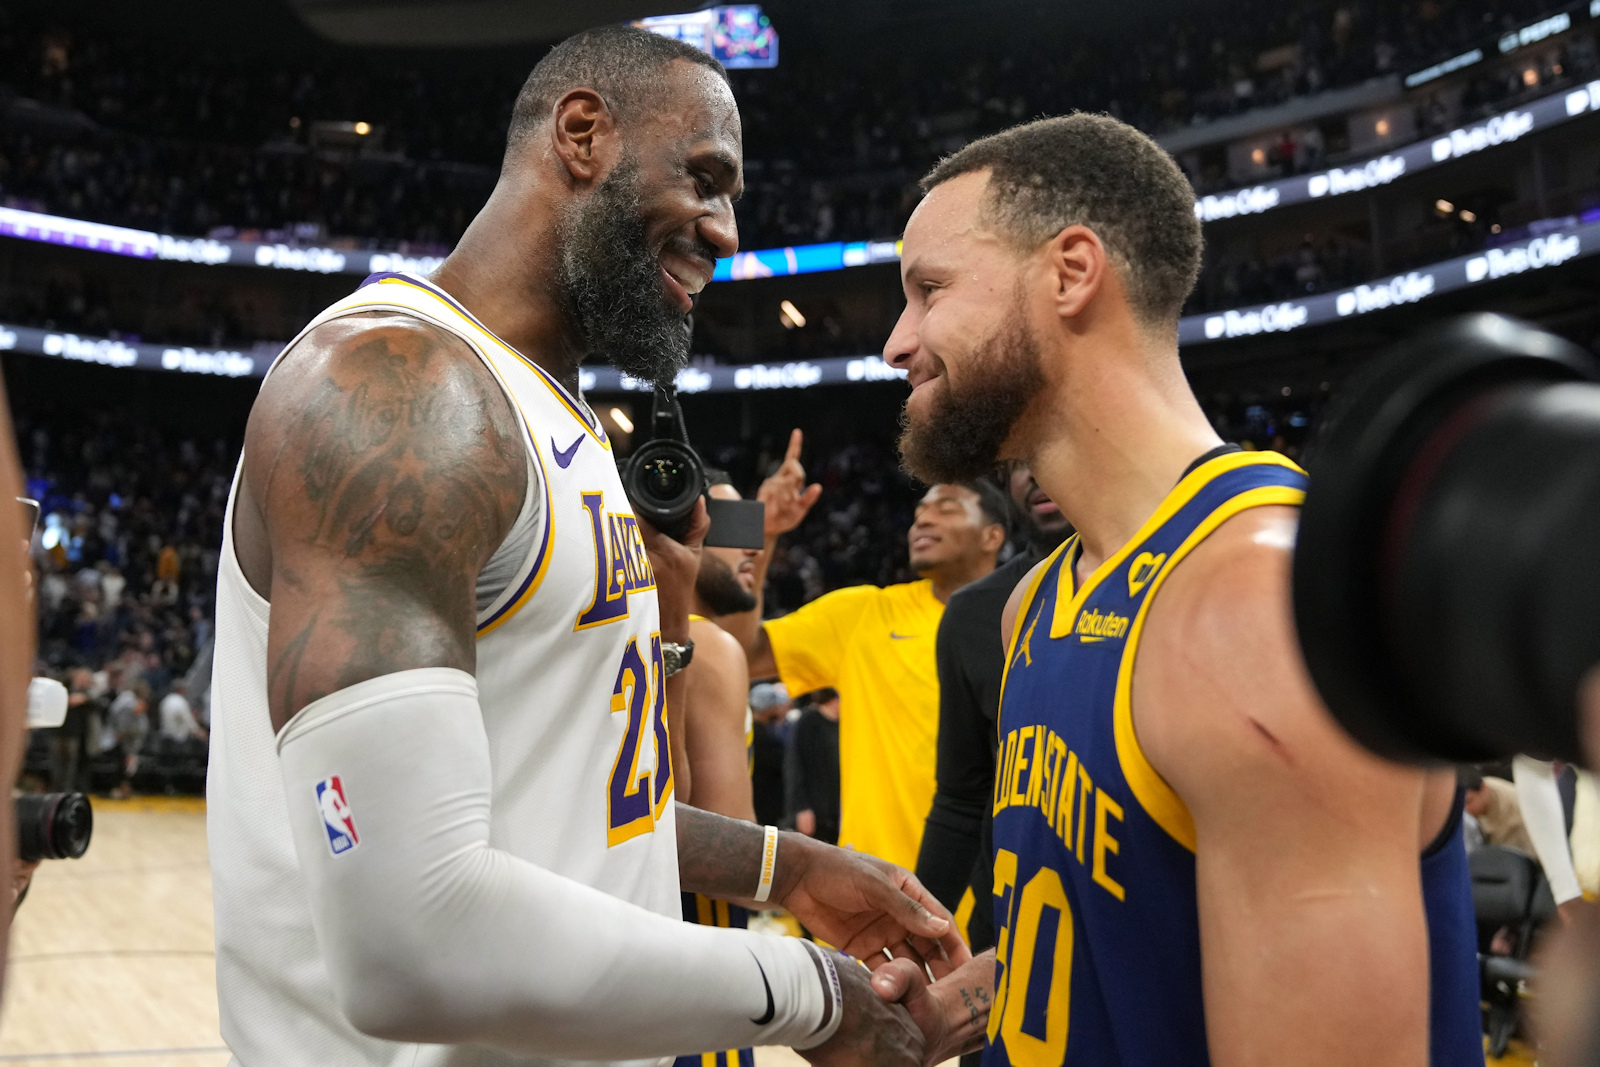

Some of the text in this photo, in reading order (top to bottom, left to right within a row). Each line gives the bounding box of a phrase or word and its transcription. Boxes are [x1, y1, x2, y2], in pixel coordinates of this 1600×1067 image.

[574, 490, 657, 631] LAKE
[1075, 608, 1129, 639] Rakuten
[608, 632, 674, 848] 23
[762, 835, 776, 885] PROMISE
[992, 724, 1126, 902] LDEN STATE
[821, 950, 842, 1009] ROMISE
[986, 847, 1074, 1067] 30
